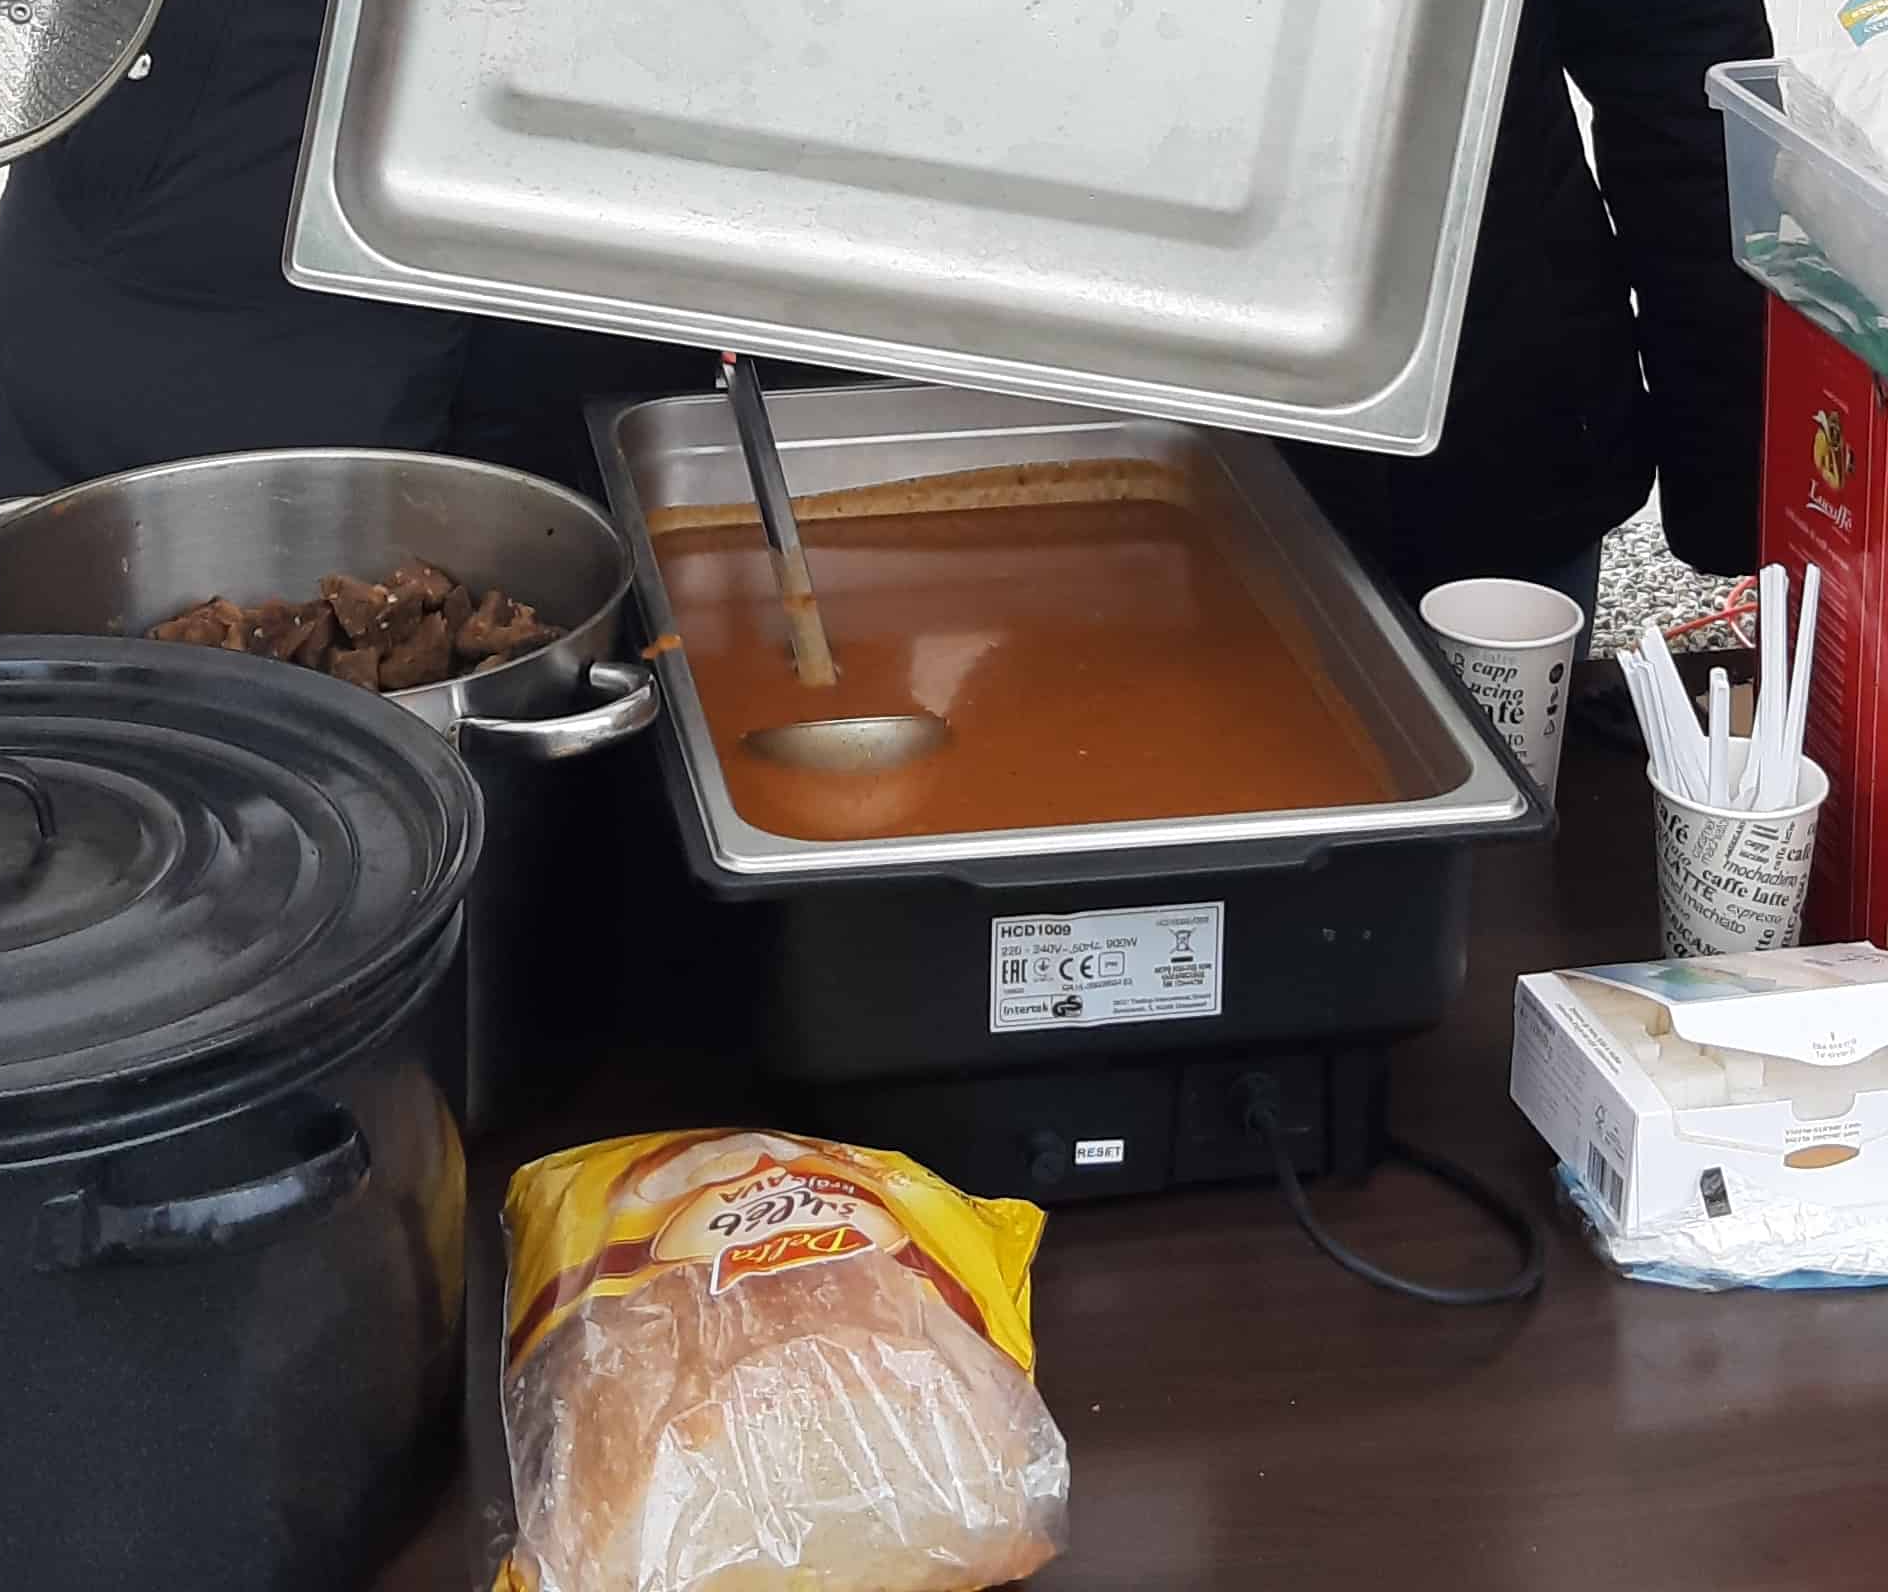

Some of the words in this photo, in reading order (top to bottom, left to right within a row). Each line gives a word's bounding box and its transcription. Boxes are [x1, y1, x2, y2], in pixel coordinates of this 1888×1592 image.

[1702, 869, 1749, 898] caffe
[1077, 1146, 1121, 1160] RESET
[731, 1226, 861, 1264] Delta
